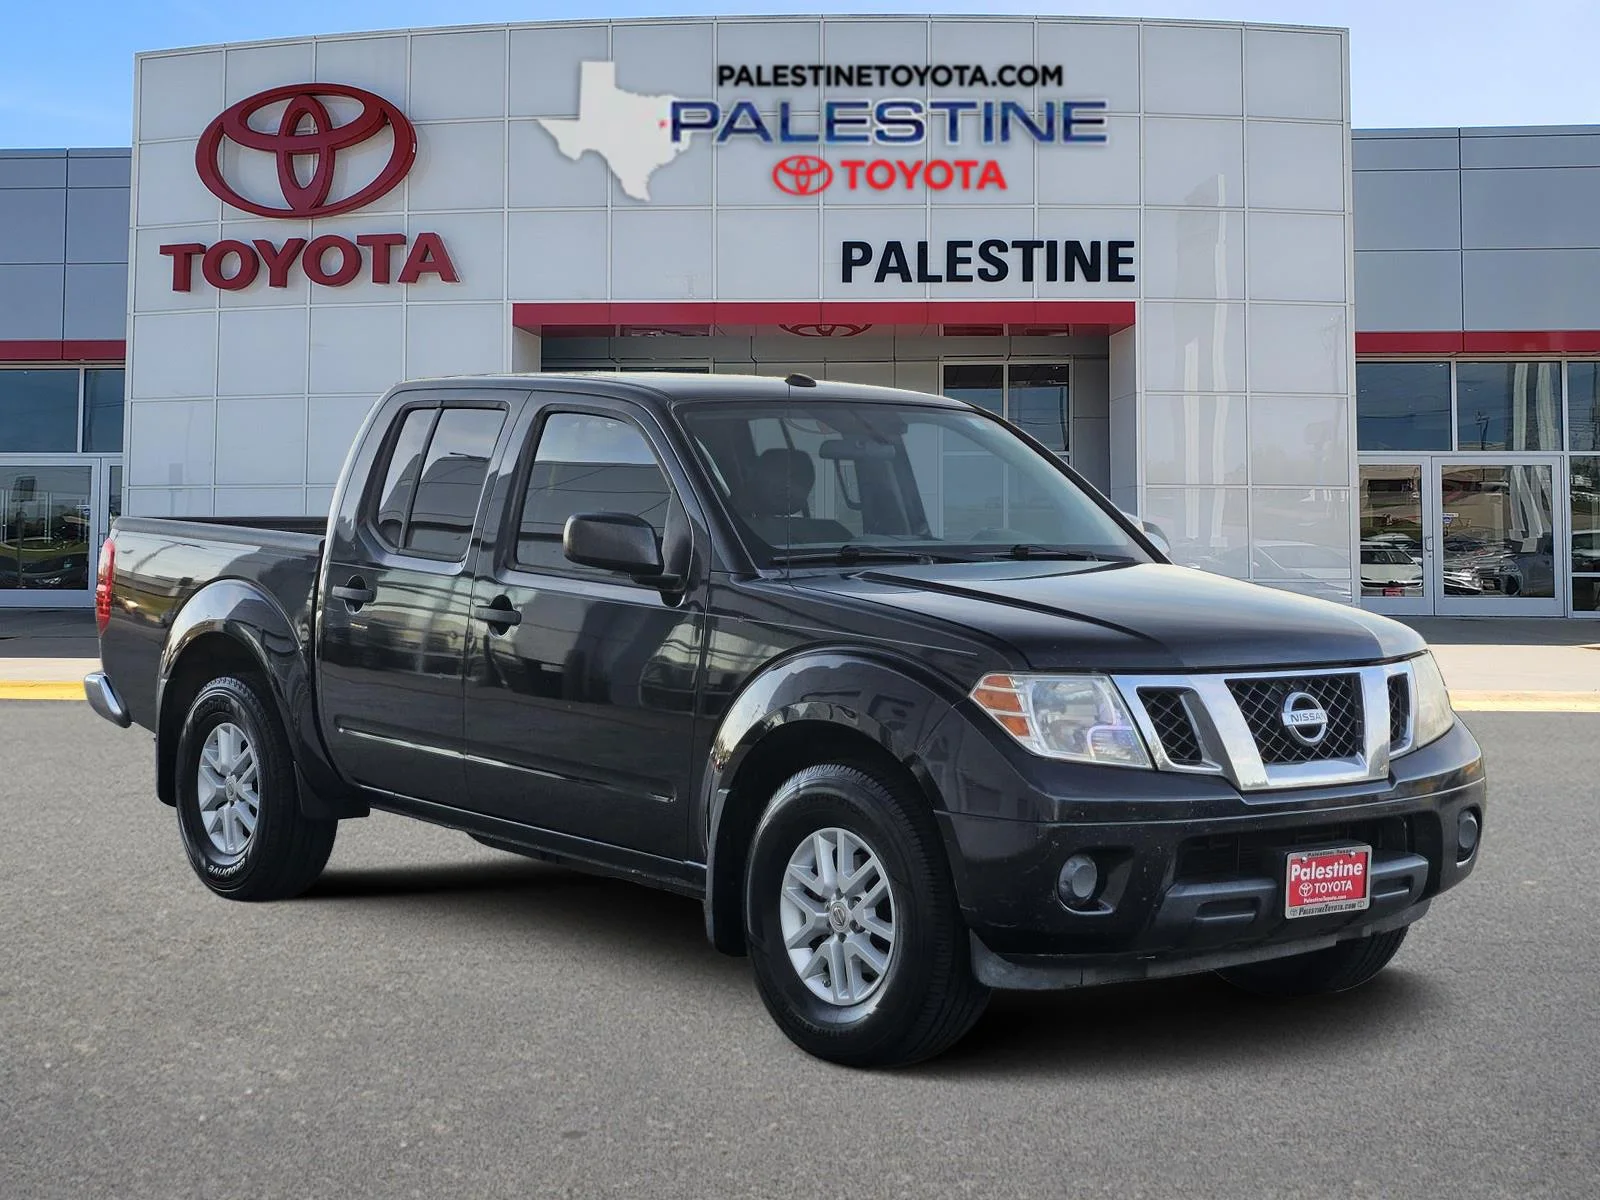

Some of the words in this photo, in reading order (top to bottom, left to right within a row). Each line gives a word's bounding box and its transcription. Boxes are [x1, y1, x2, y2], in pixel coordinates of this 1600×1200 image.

[159, 232, 461, 293] TOYOTA
[841, 240, 1136, 283] PALESTINE
[1290, 712, 1326, 723] NISSAN
[1291, 859, 1363, 881] Palestine
[1314, 880, 1352, 893] TOYOTA
